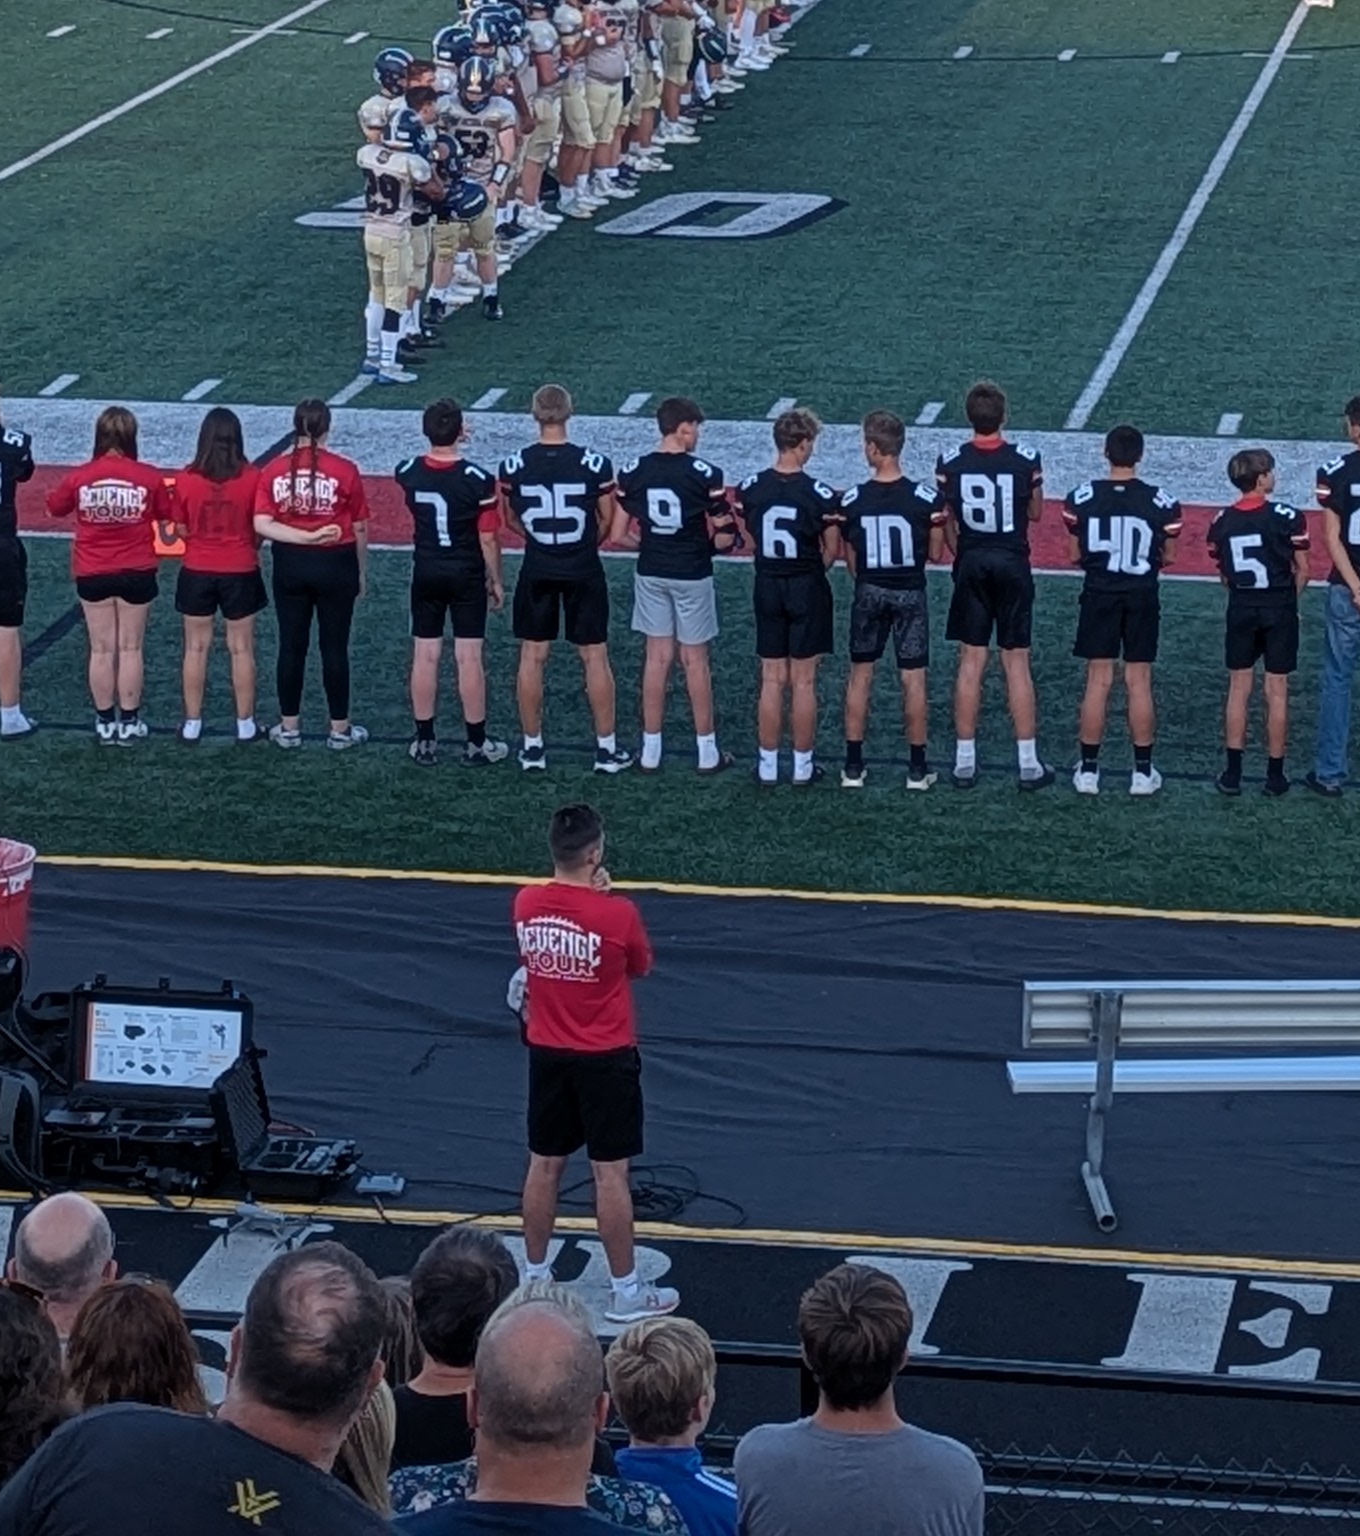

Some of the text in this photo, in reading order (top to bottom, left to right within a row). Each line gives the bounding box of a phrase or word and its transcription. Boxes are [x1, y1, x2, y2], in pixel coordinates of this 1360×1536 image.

[79, 485, 148, 507] REVENGE
[85, 505, 142, 521] TOUR
[415, 491, 453, 548] 7
[521, 483, 587, 546] 25
[646, 487, 685, 536] 9
[959, 473, 1015, 533] 81
[761, 504, 798, 559] 6
[860, 515, 916, 569] 10
[1087, 516, 1154, 576] 40
[1229, 534, 1270, 589] 5
[516, 921, 602, 966] REVENGE
[526, 951, 596, 977] TOUR
